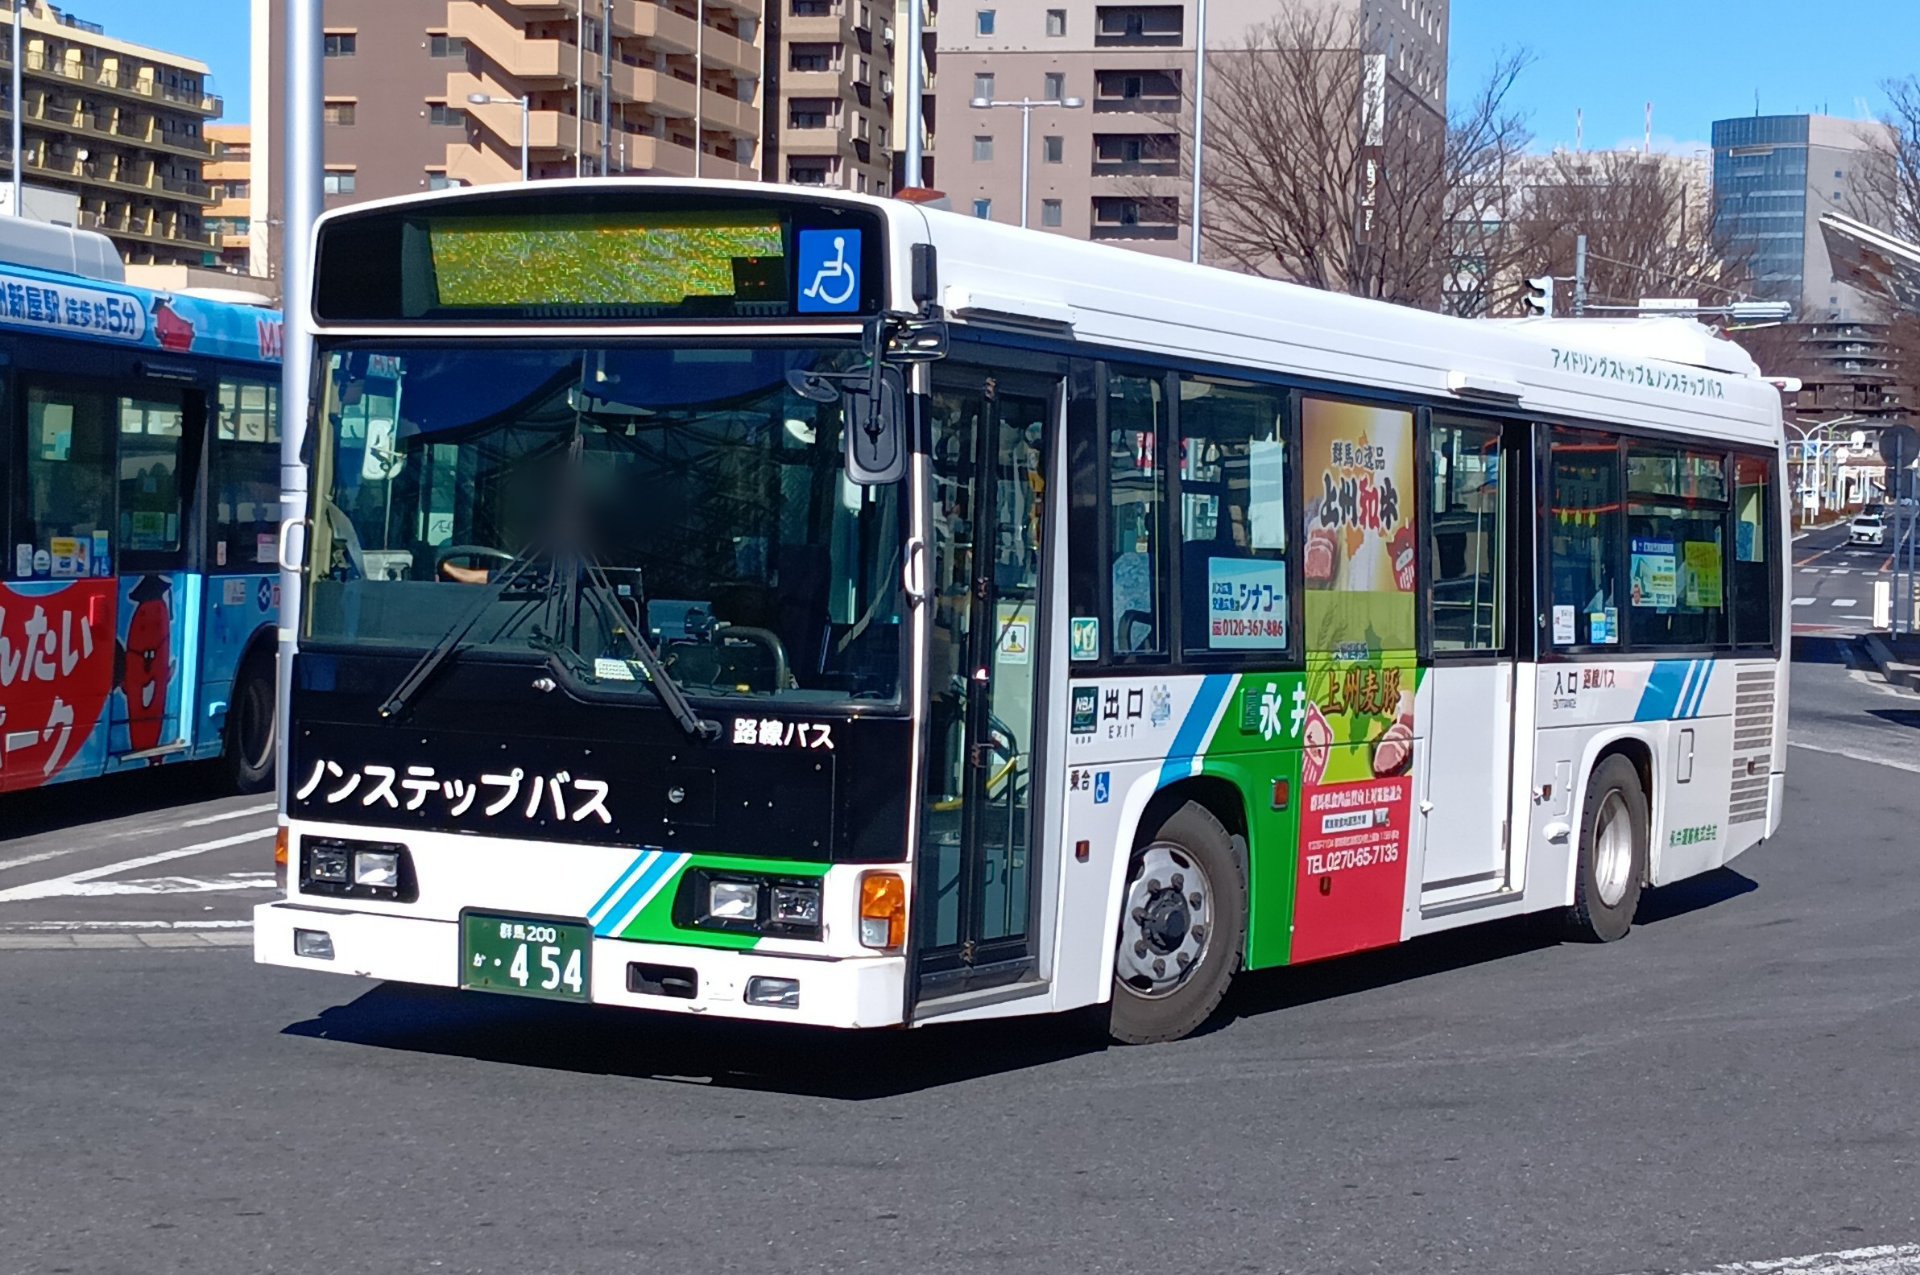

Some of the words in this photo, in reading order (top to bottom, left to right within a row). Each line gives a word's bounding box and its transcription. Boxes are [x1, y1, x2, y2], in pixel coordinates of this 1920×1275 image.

[1551, 348, 1724, 399] アイドリングストップ&ノンステップバス
[1332, 441, 1385, 471] 群馬の逸品
[1320, 474, 1398, 530] 上州和牛
[1240, 584, 1283, 611] シナコー
[1321, 666, 1401, 717] 上州麦豚
[1554, 671, 1577, 695] 入口
[1103, 688, 1143, 720] 出口
[733, 718, 834, 749] 路線バス
[1109, 724, 1134, 739] EXIT
[296, 759, 612, 824] ノンステップバス
